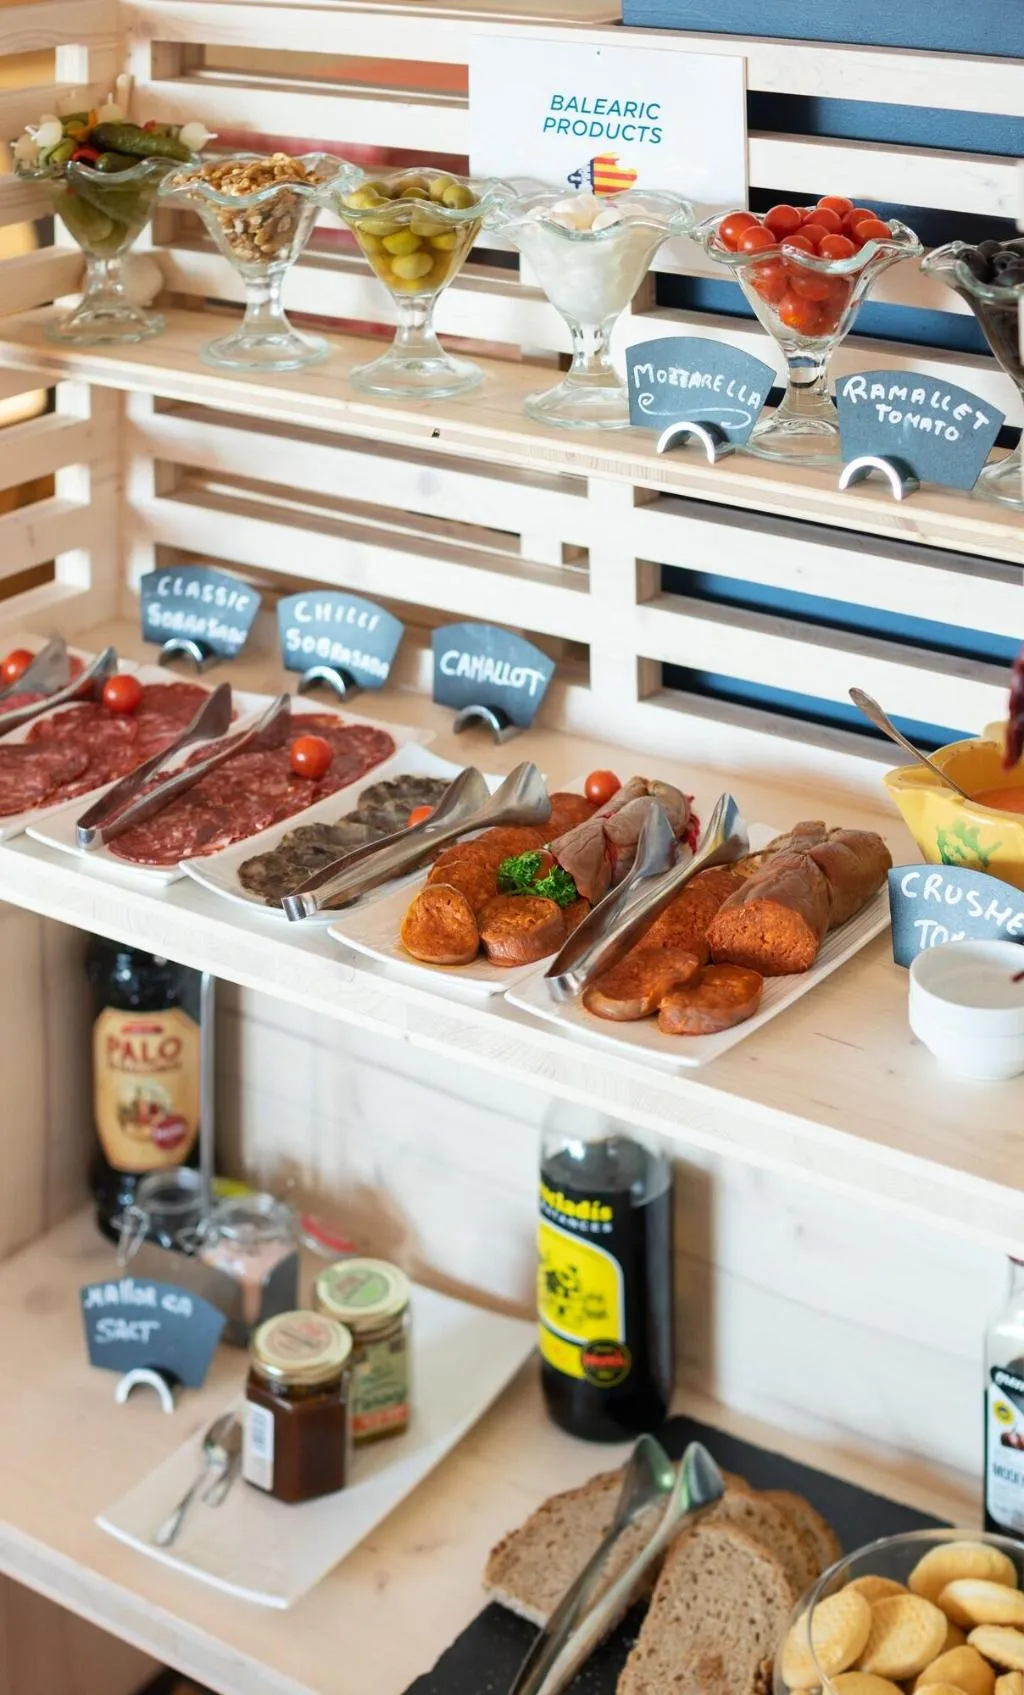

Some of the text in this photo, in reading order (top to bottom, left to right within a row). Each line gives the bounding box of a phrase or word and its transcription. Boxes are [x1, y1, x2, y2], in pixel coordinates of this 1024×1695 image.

[550, 95, 661, 120] BALEARIC
[543, 117, 663, 144] PRODUCTS
[633, 363, 762, 409] MOZZARELLA
[842, 375, 989, 430] RAMALLET
[875, 403, 960, 441] TOMATO
[157, 576, 250, 612] CLASSIC
[294, 600, 380, 632] CHILLI
[106, 1035, 183, 1063] PALO
